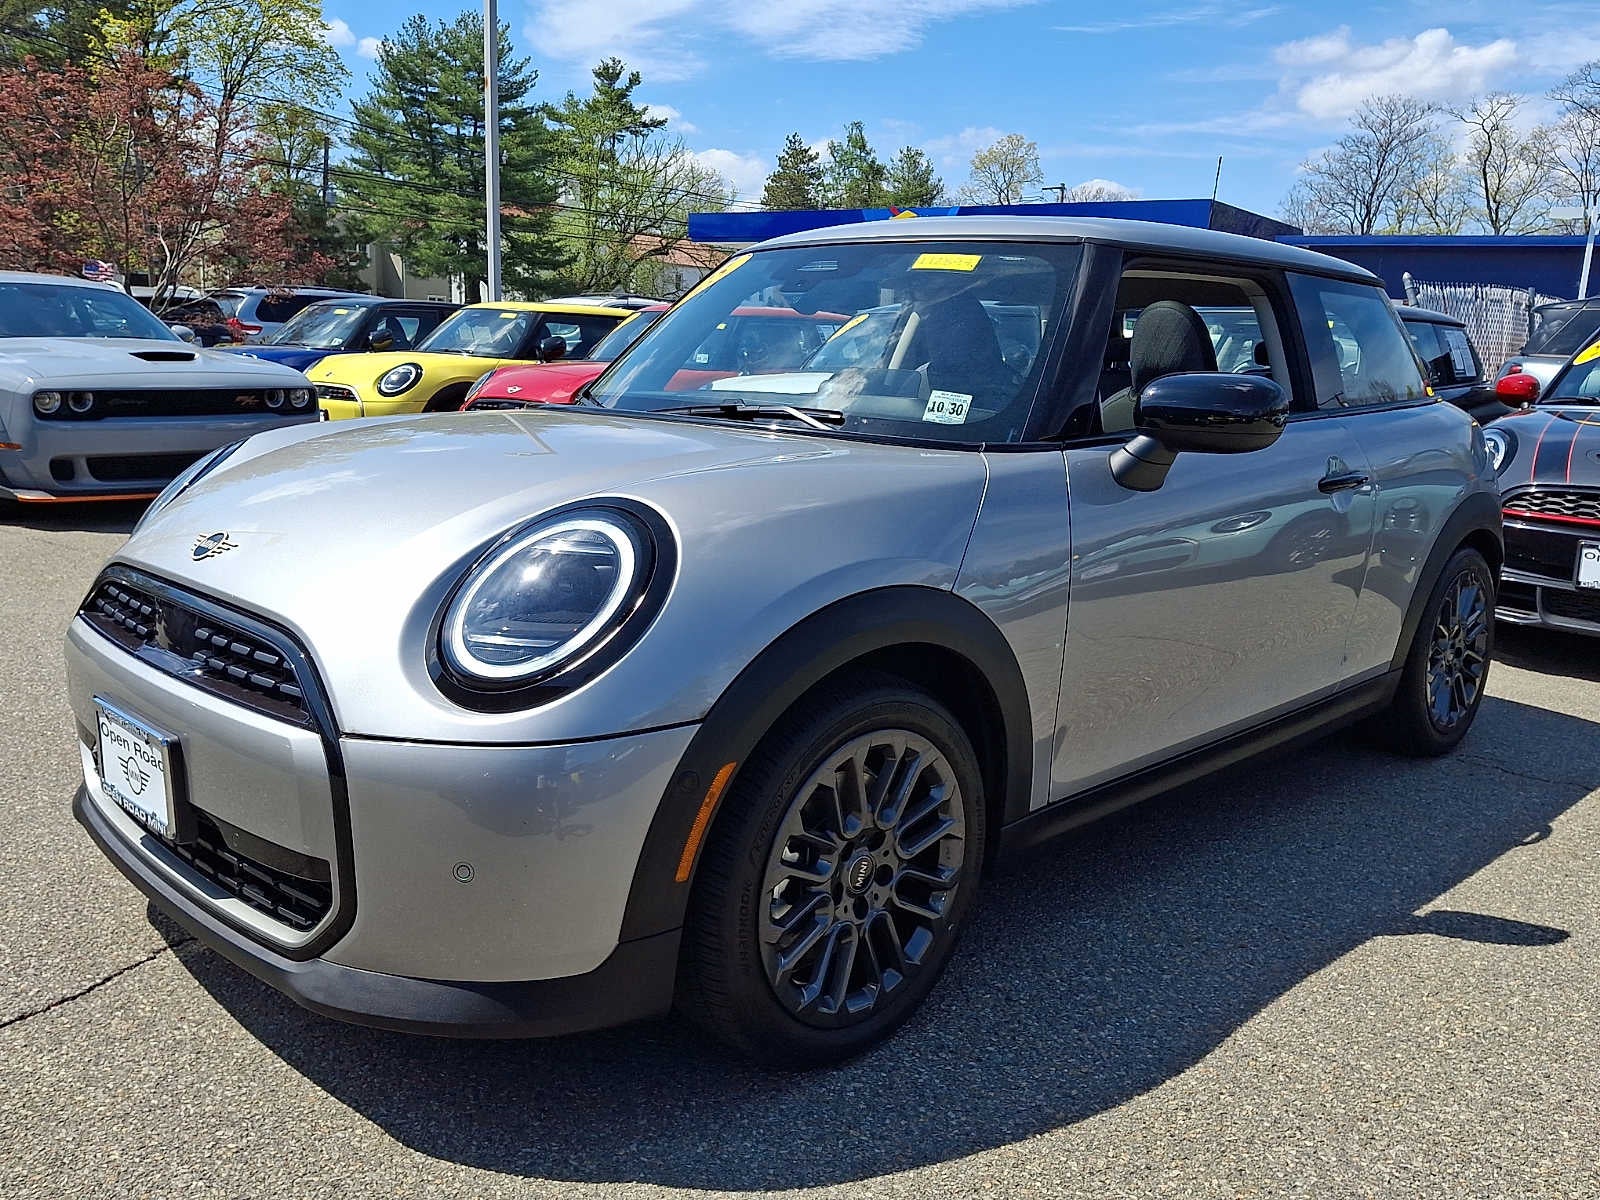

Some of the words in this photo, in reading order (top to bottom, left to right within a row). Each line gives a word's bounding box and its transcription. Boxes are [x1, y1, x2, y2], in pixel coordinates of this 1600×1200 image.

[929, 401, 944, 413] 10
[948, 402, 963, 416] 30
[101, 722, 130, 751] Open
[123, 800, 146, 821] ROAD
[856, 861, 868, 887] MINI
